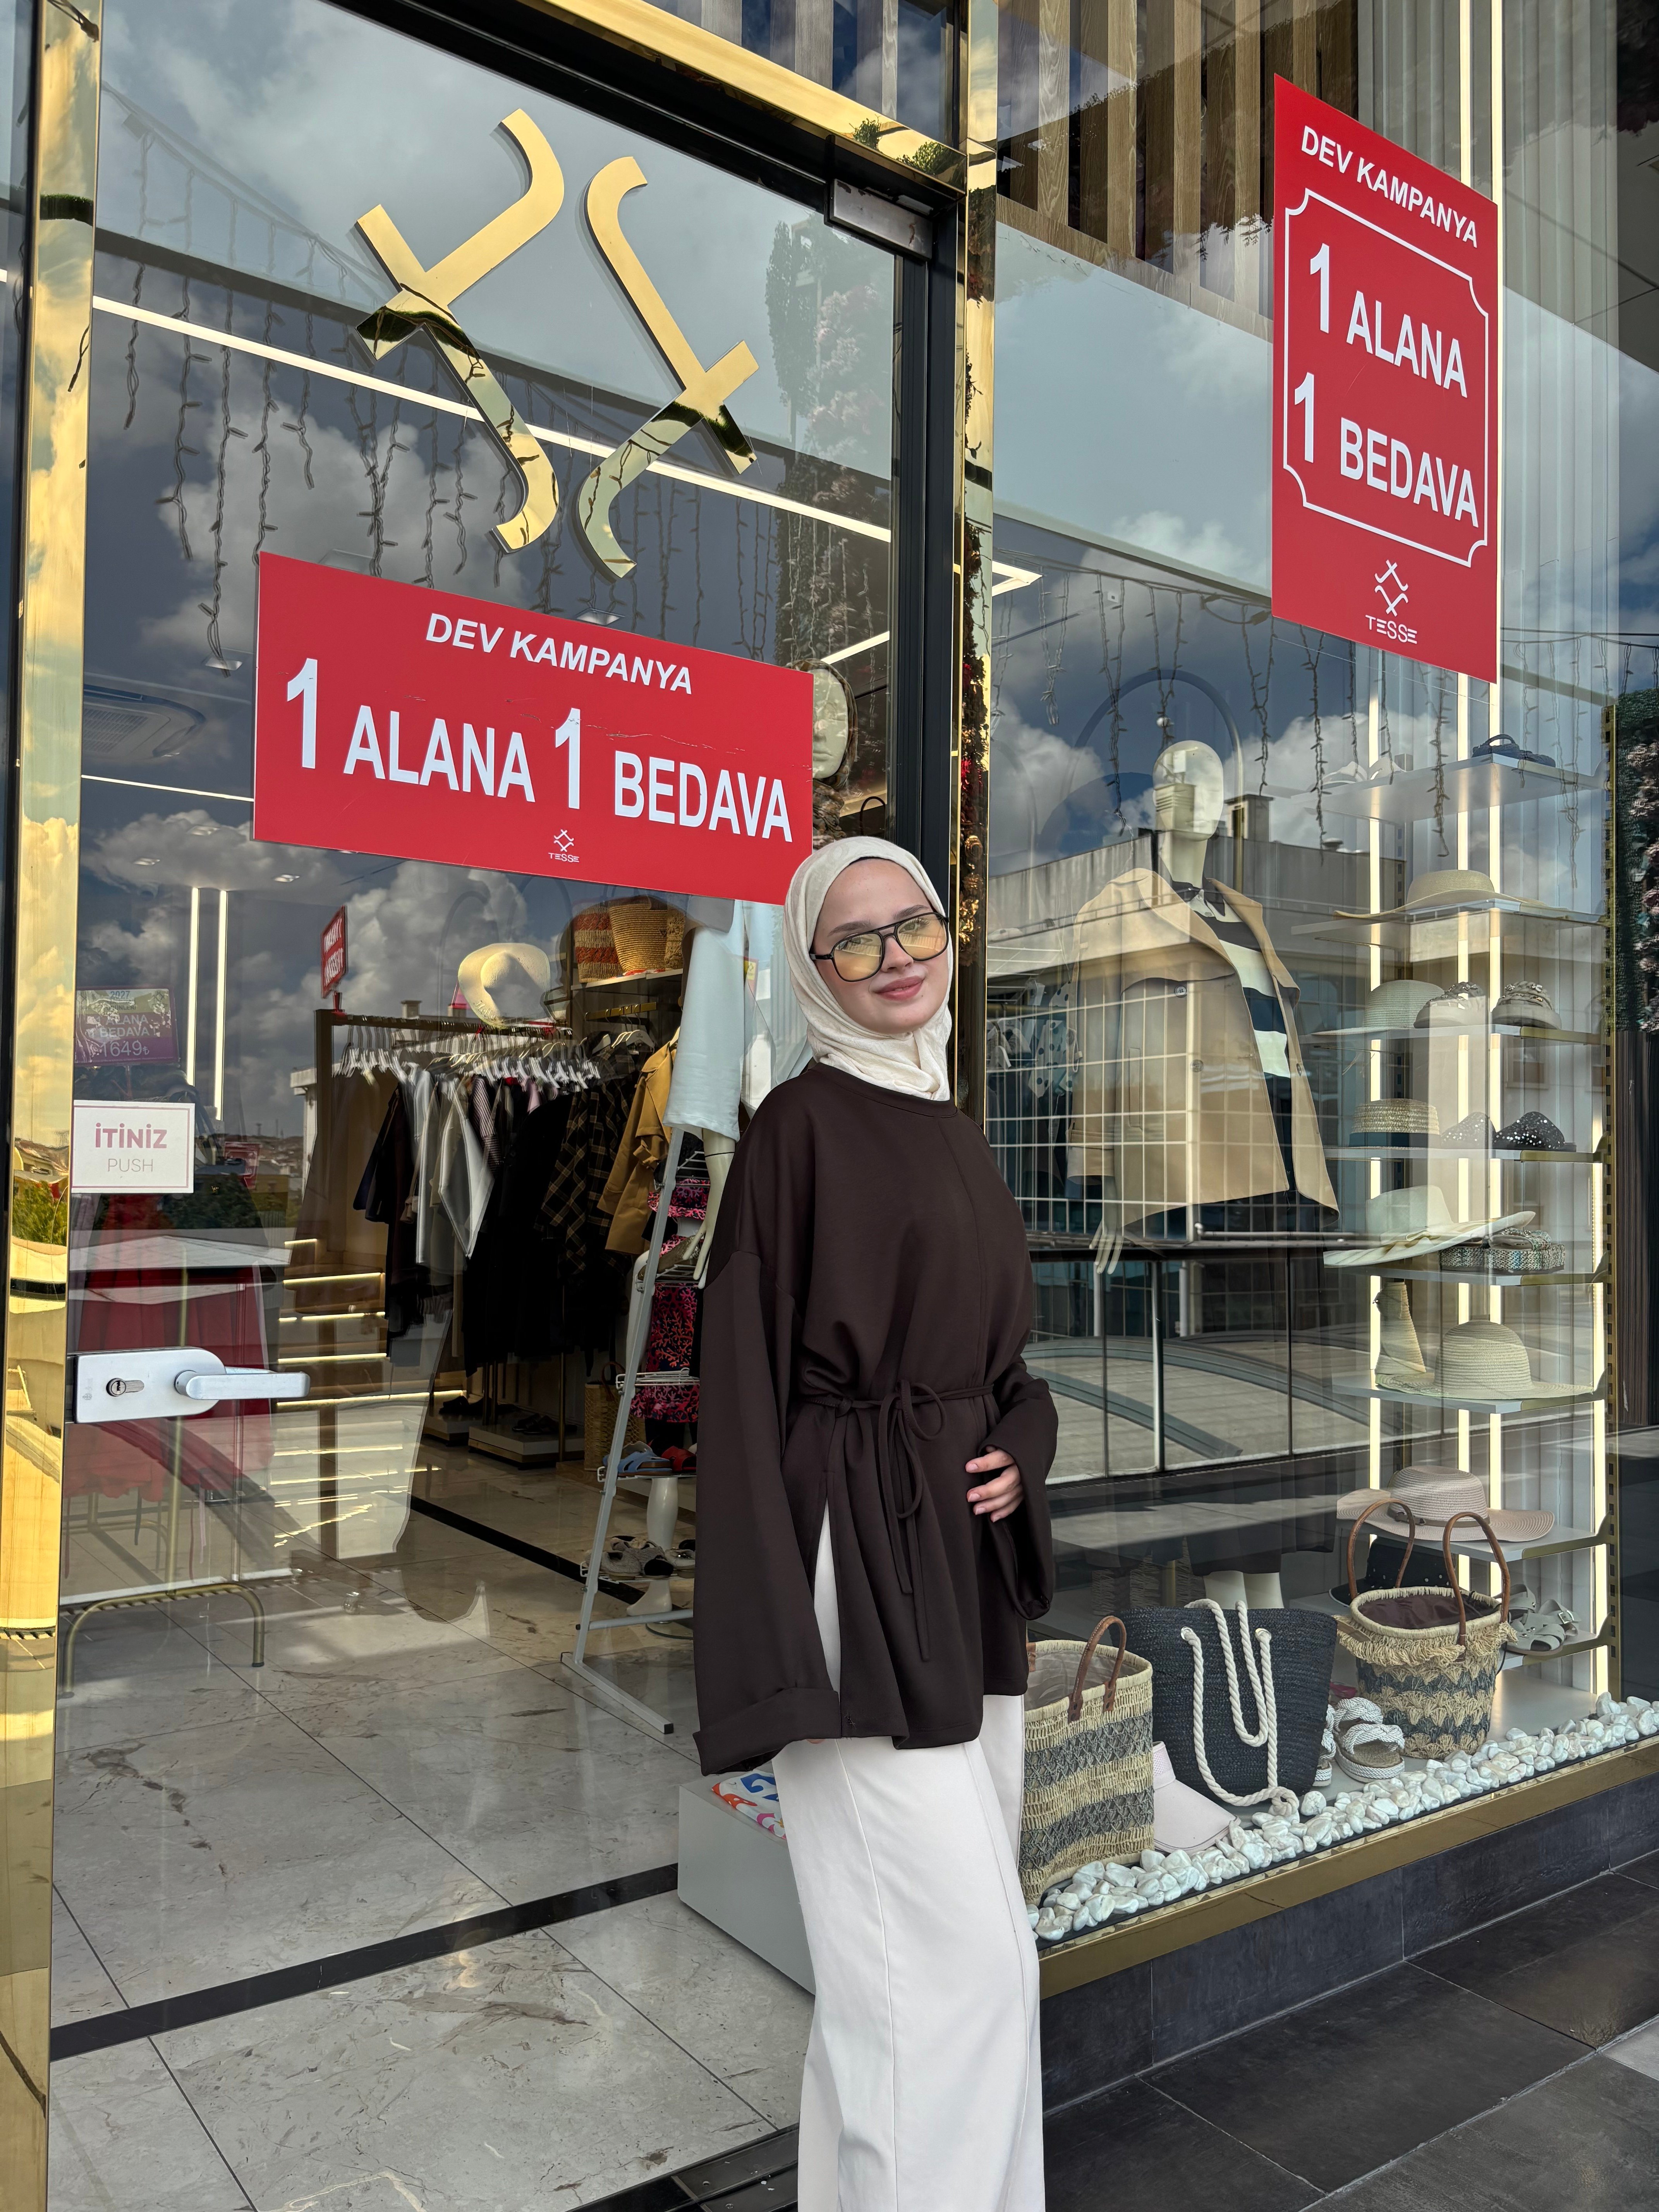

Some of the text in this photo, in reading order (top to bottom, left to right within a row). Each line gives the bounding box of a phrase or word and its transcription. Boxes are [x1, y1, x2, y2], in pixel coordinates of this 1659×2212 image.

[1301, 125, 1477, 249] DEV KAMPANYA
[1310, 243, 1468, 398] 1 ALANA
[1294, 372, 1479, 528] 1 BEDAVA
[426, 613, 692, 695] DEV KAMPANYA
[1365, 614, 1418, 645] TESSE
[287, 658, 793, 843] 1 ALANA 1 BEDAVA
[548, 852, 580, 863] TESSE
[100, 1027, 150, 1037] BEDAVA
[95, 1122, 167, 1149] İTİNİZ
[107, 1158, 153, 1172] PUSH
